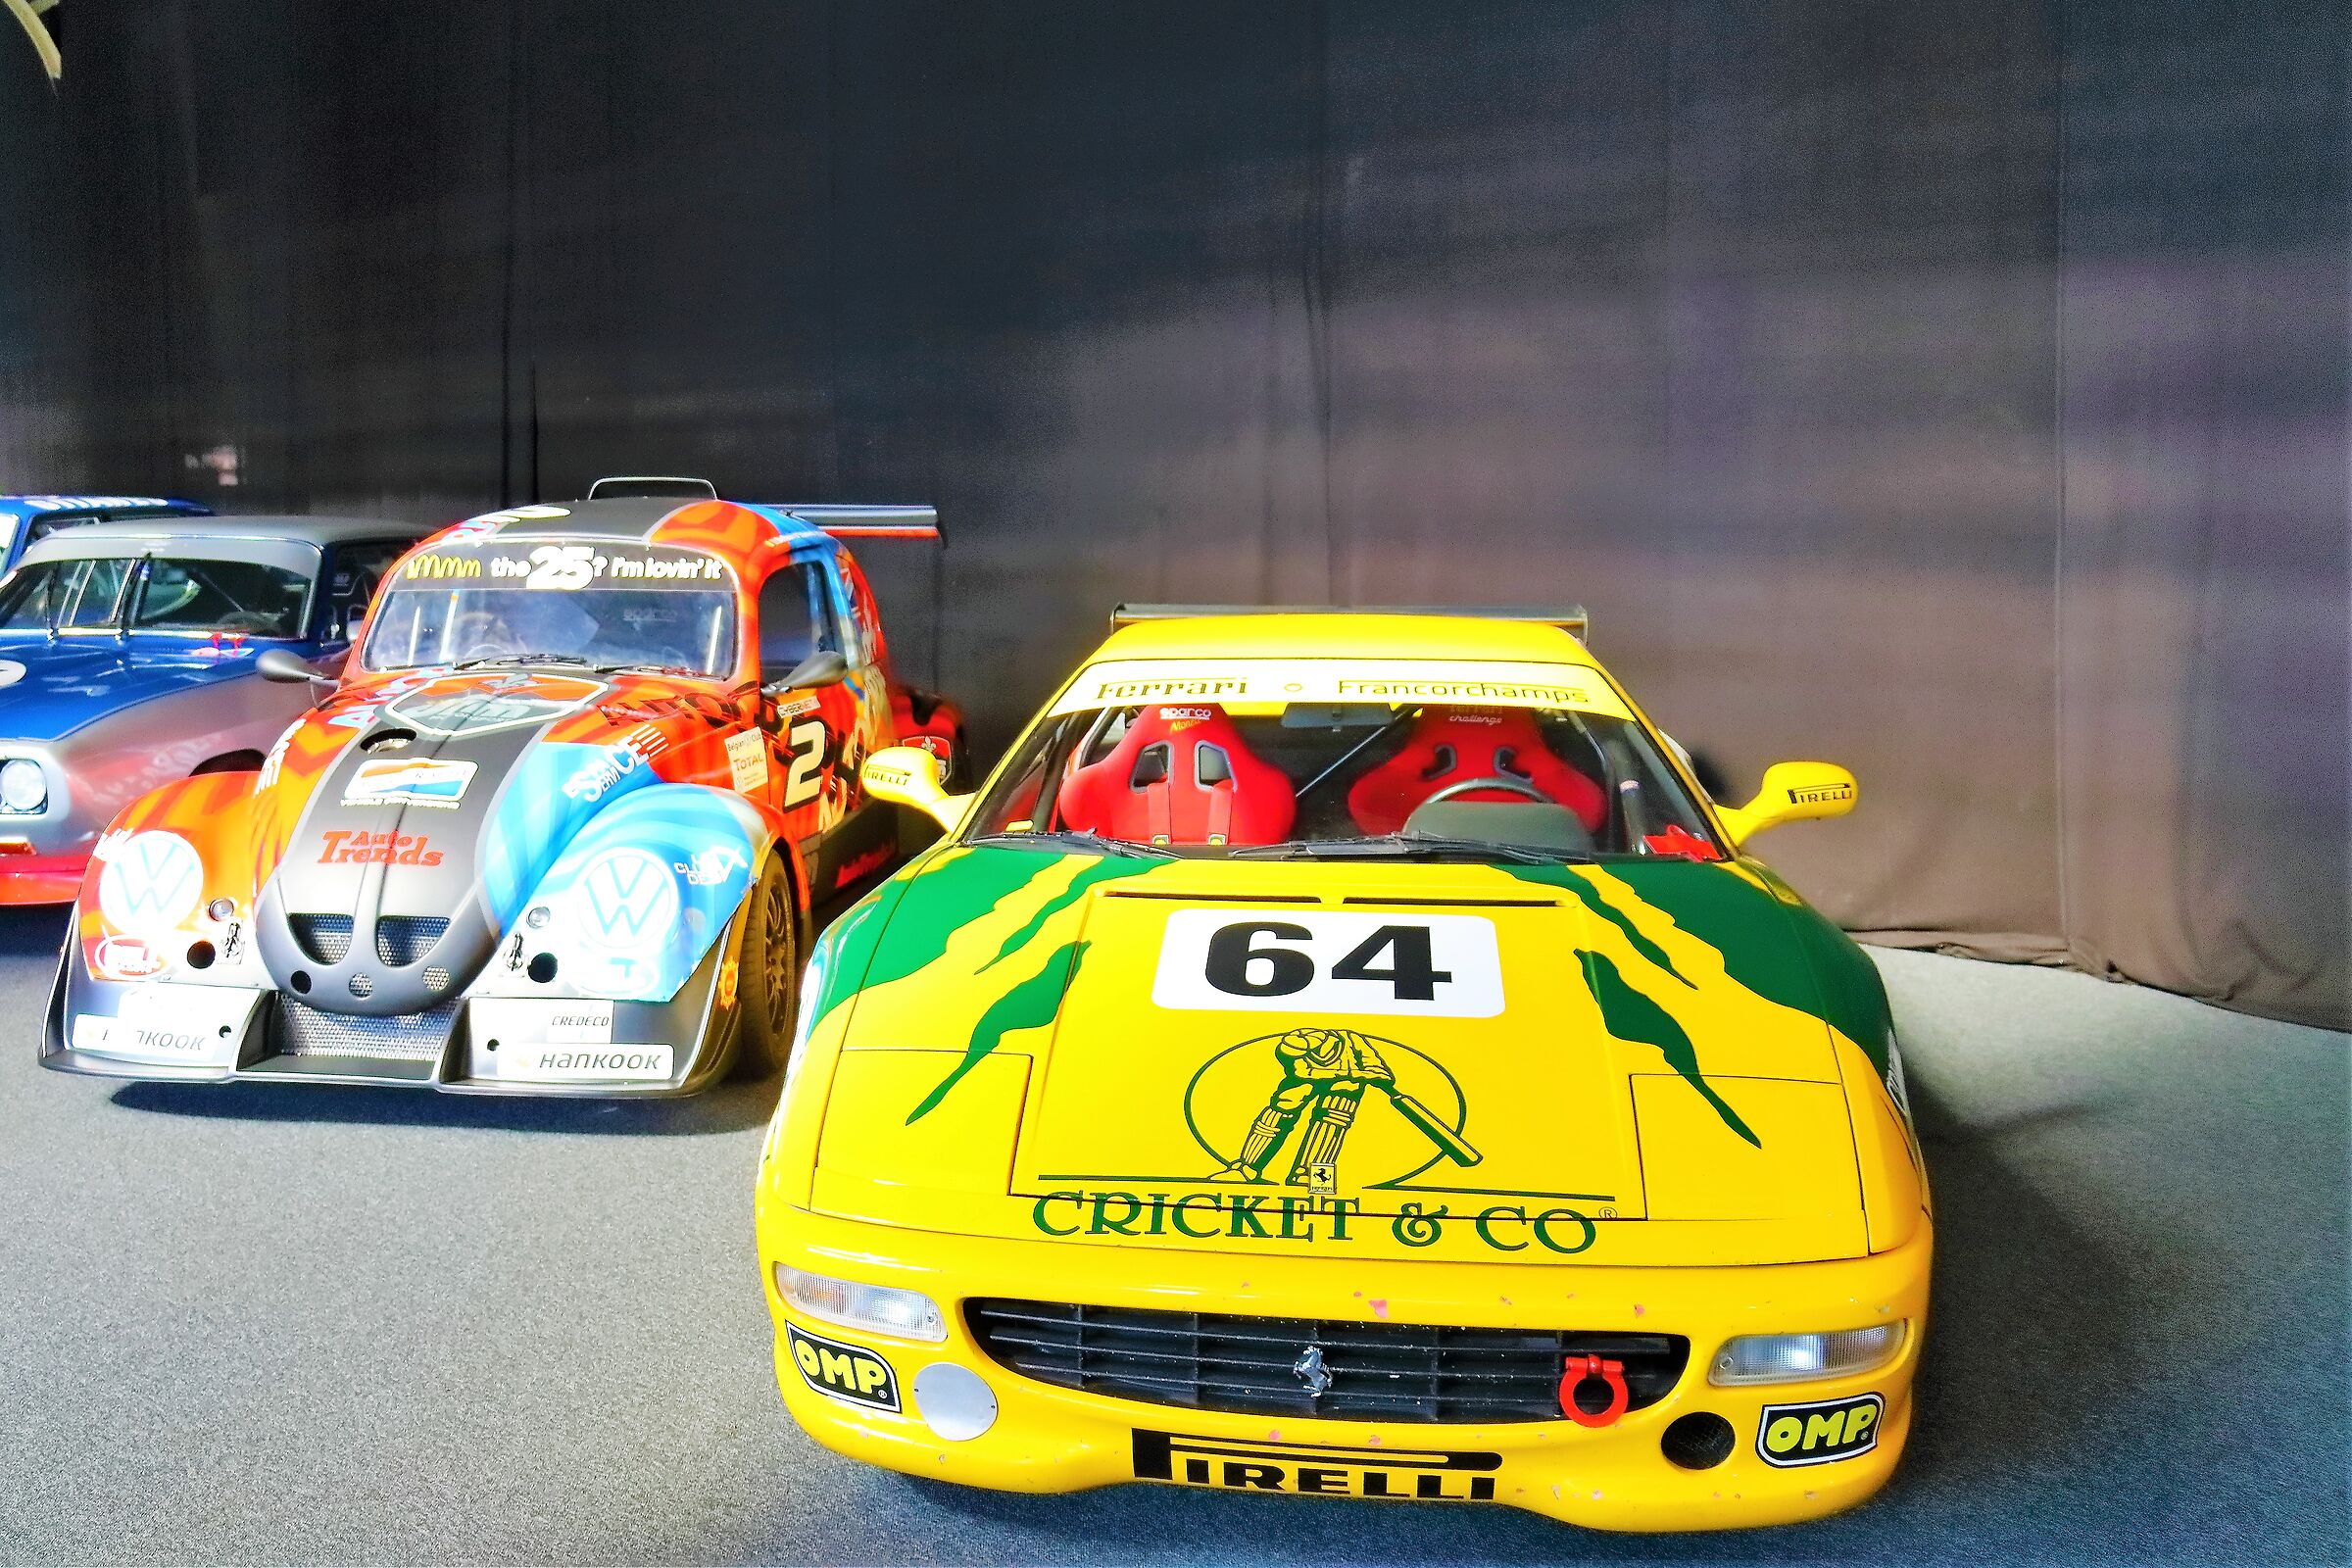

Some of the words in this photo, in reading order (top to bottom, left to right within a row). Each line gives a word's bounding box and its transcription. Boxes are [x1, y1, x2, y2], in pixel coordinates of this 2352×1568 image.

[491, 556, 532, 578] the
[1095, 677, 1248, 700] Ferrari
[1339, 680, 1591, 704] Francorchamps
[1159, 707, 1212, 720] sparco
[785, 720, 826, 809] 2
[1787, 782, 1853, 805] PIRELLI
[318, 830, 445, 867] Trends
[350, 830, 414, 847] Auto
[1205, 921, 1452, 1002] 64
[1032, 1190, 1361, 1244] CRICKET
[1391, 1201, 1449, 1248] &
[794, 1338, 888, 1397] OMP
[1765, 1402, 1880, 1454] OMP
[1133, 1428, 1504, 1501] PIRELLI
